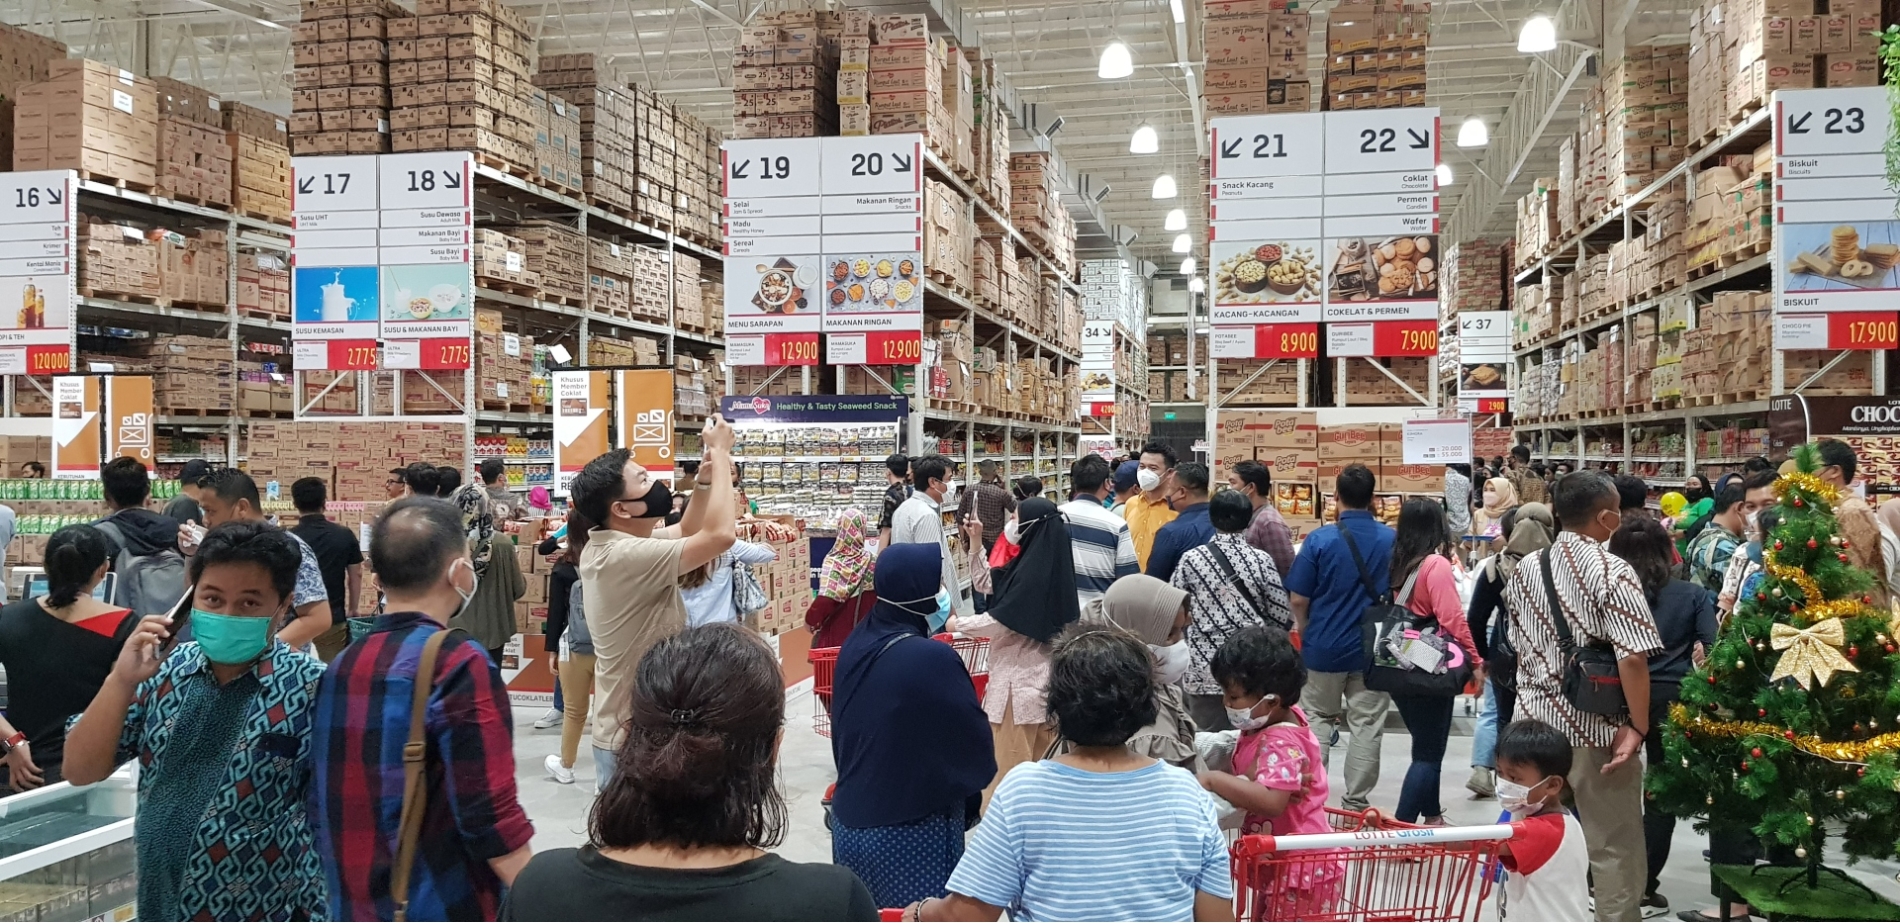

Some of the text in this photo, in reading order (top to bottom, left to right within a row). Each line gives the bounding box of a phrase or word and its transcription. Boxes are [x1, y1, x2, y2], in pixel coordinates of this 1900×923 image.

[1824, 107, 1865, 134] 23
[1360, 128, 1396, 153] 22
[1253, 134, 1288, 159] 21
[760, 156, 790, 180] 19
[851, 153, 883, 176] 20
[1789, 160, 1818, 168] Biskuit
[324, 173, 351, 194] 17
[407, 170, 436, 192] 18
[1246, 181, 1274, 190] Kacang
[15, 187, 40, 208] 16
[856, 196, 912, 206] Makanan Ringan
[1397, 196, 1428, 204] Permen
[733, 200, 750, 208] Selai
[733, 220, 751, 228] Madu
[1402, 217, 1427, 226] Wafer
[446, 229, 461, 237] Bayi
[446, 248, 460, 256] Bayi
[1783, 298, 1819, 307] BISKUIT
[1214, 309, 1300, 319] KACANG-KACANGAN
[1327, 306, 1410, 316] COKELAT & PERMEN
[728, 320, 784, 328] MENU SARAPAN
[826, 318, 892, 327] MAKANAN RINGAN
[1475, 319, 1492, 330] 37
[295, 327, 313, 335] SUSU
[384, 326, 401, 334] SUSU
[442, 325, 459, 333] BAYI
[1085, 328, 1099, 338] 34
[1849, 321, 1897, 344] 17.900
[776, 402, 898, 412] Healthy & Tasty Seaweed Snack
[1771, 398, 1792, 411] LOTTE
[1225, 418, 1244, 429] Pota
[1274, 417, 1297, 429] Pota
[1226, 425, 1244, 434] bee
[1276, 426, 1294, 435] bee
[1223, 455, 1243, 466] Pota
[1275, 454, 1297, 467] Pota
[1277, 463, 1295, 472] bee
